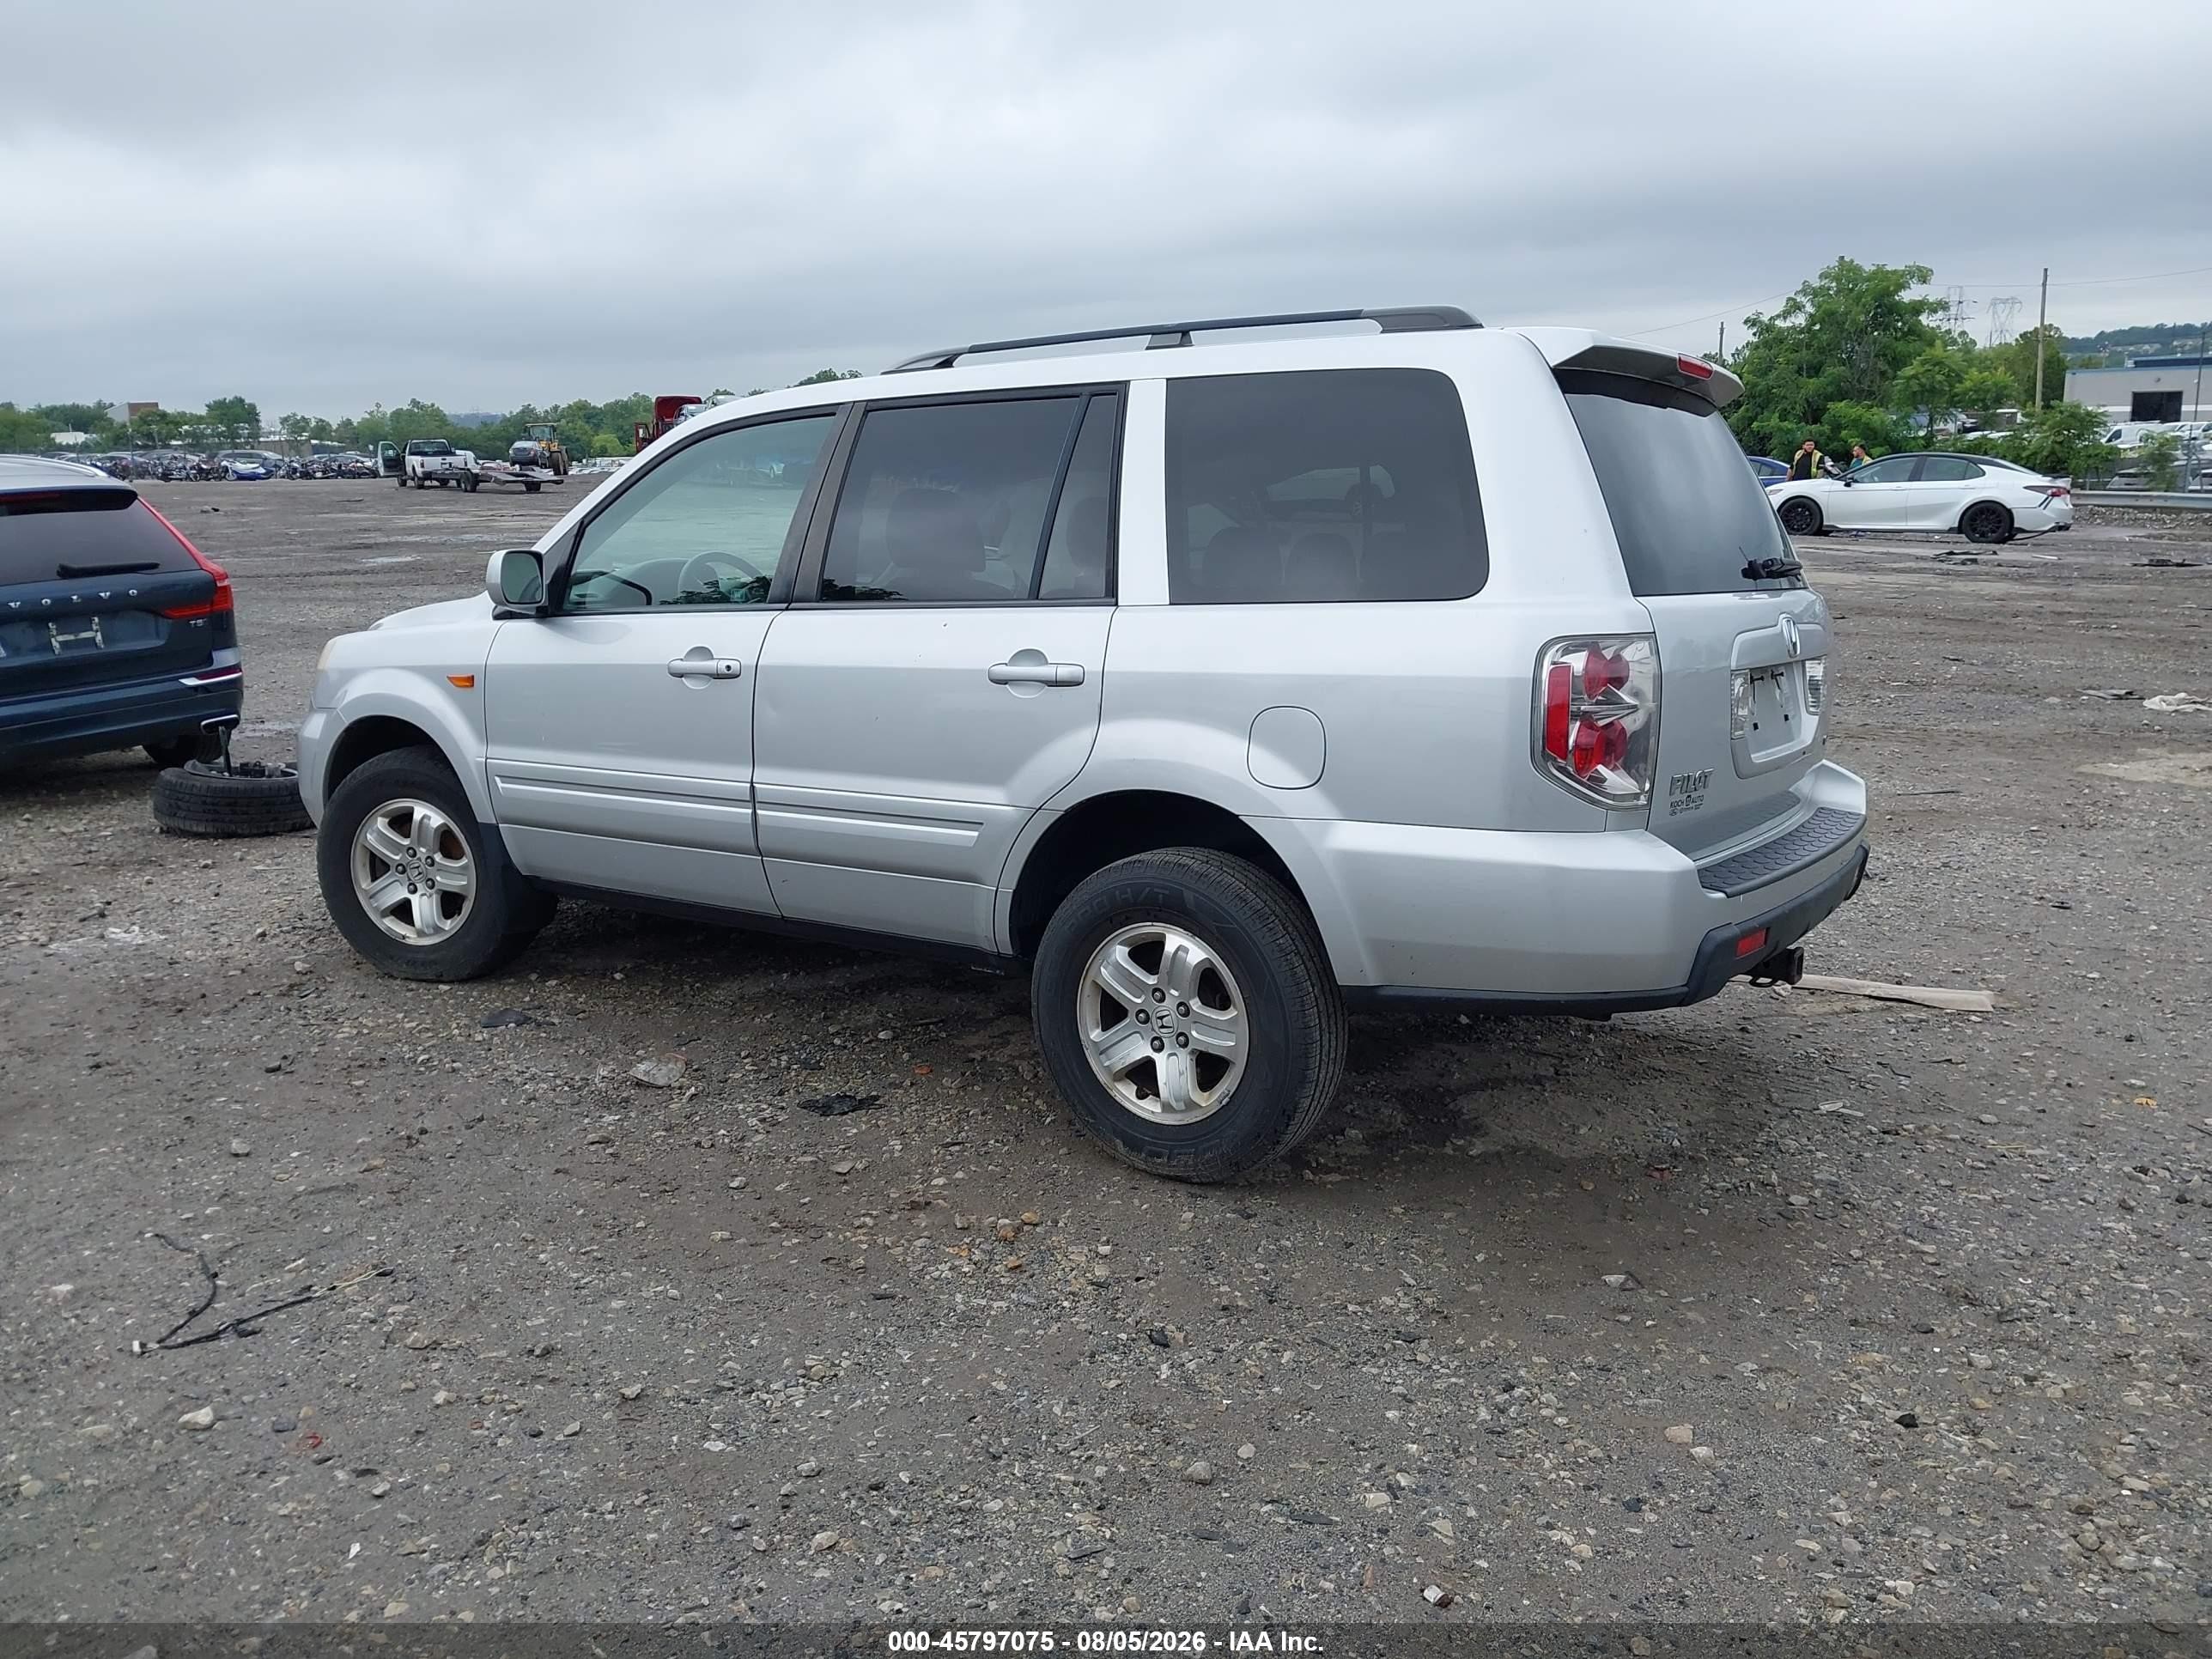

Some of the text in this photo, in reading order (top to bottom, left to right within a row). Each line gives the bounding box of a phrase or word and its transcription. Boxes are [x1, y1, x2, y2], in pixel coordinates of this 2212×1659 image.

[8, 588, 138, 609] VOLVO
[1669, 768, 1716, 797] PILOT
[1669, 798, 1685, 809] KOCH
[1691, 794, 1705, 805] AUTO
[1115, 887, 1169, 905] H/T
